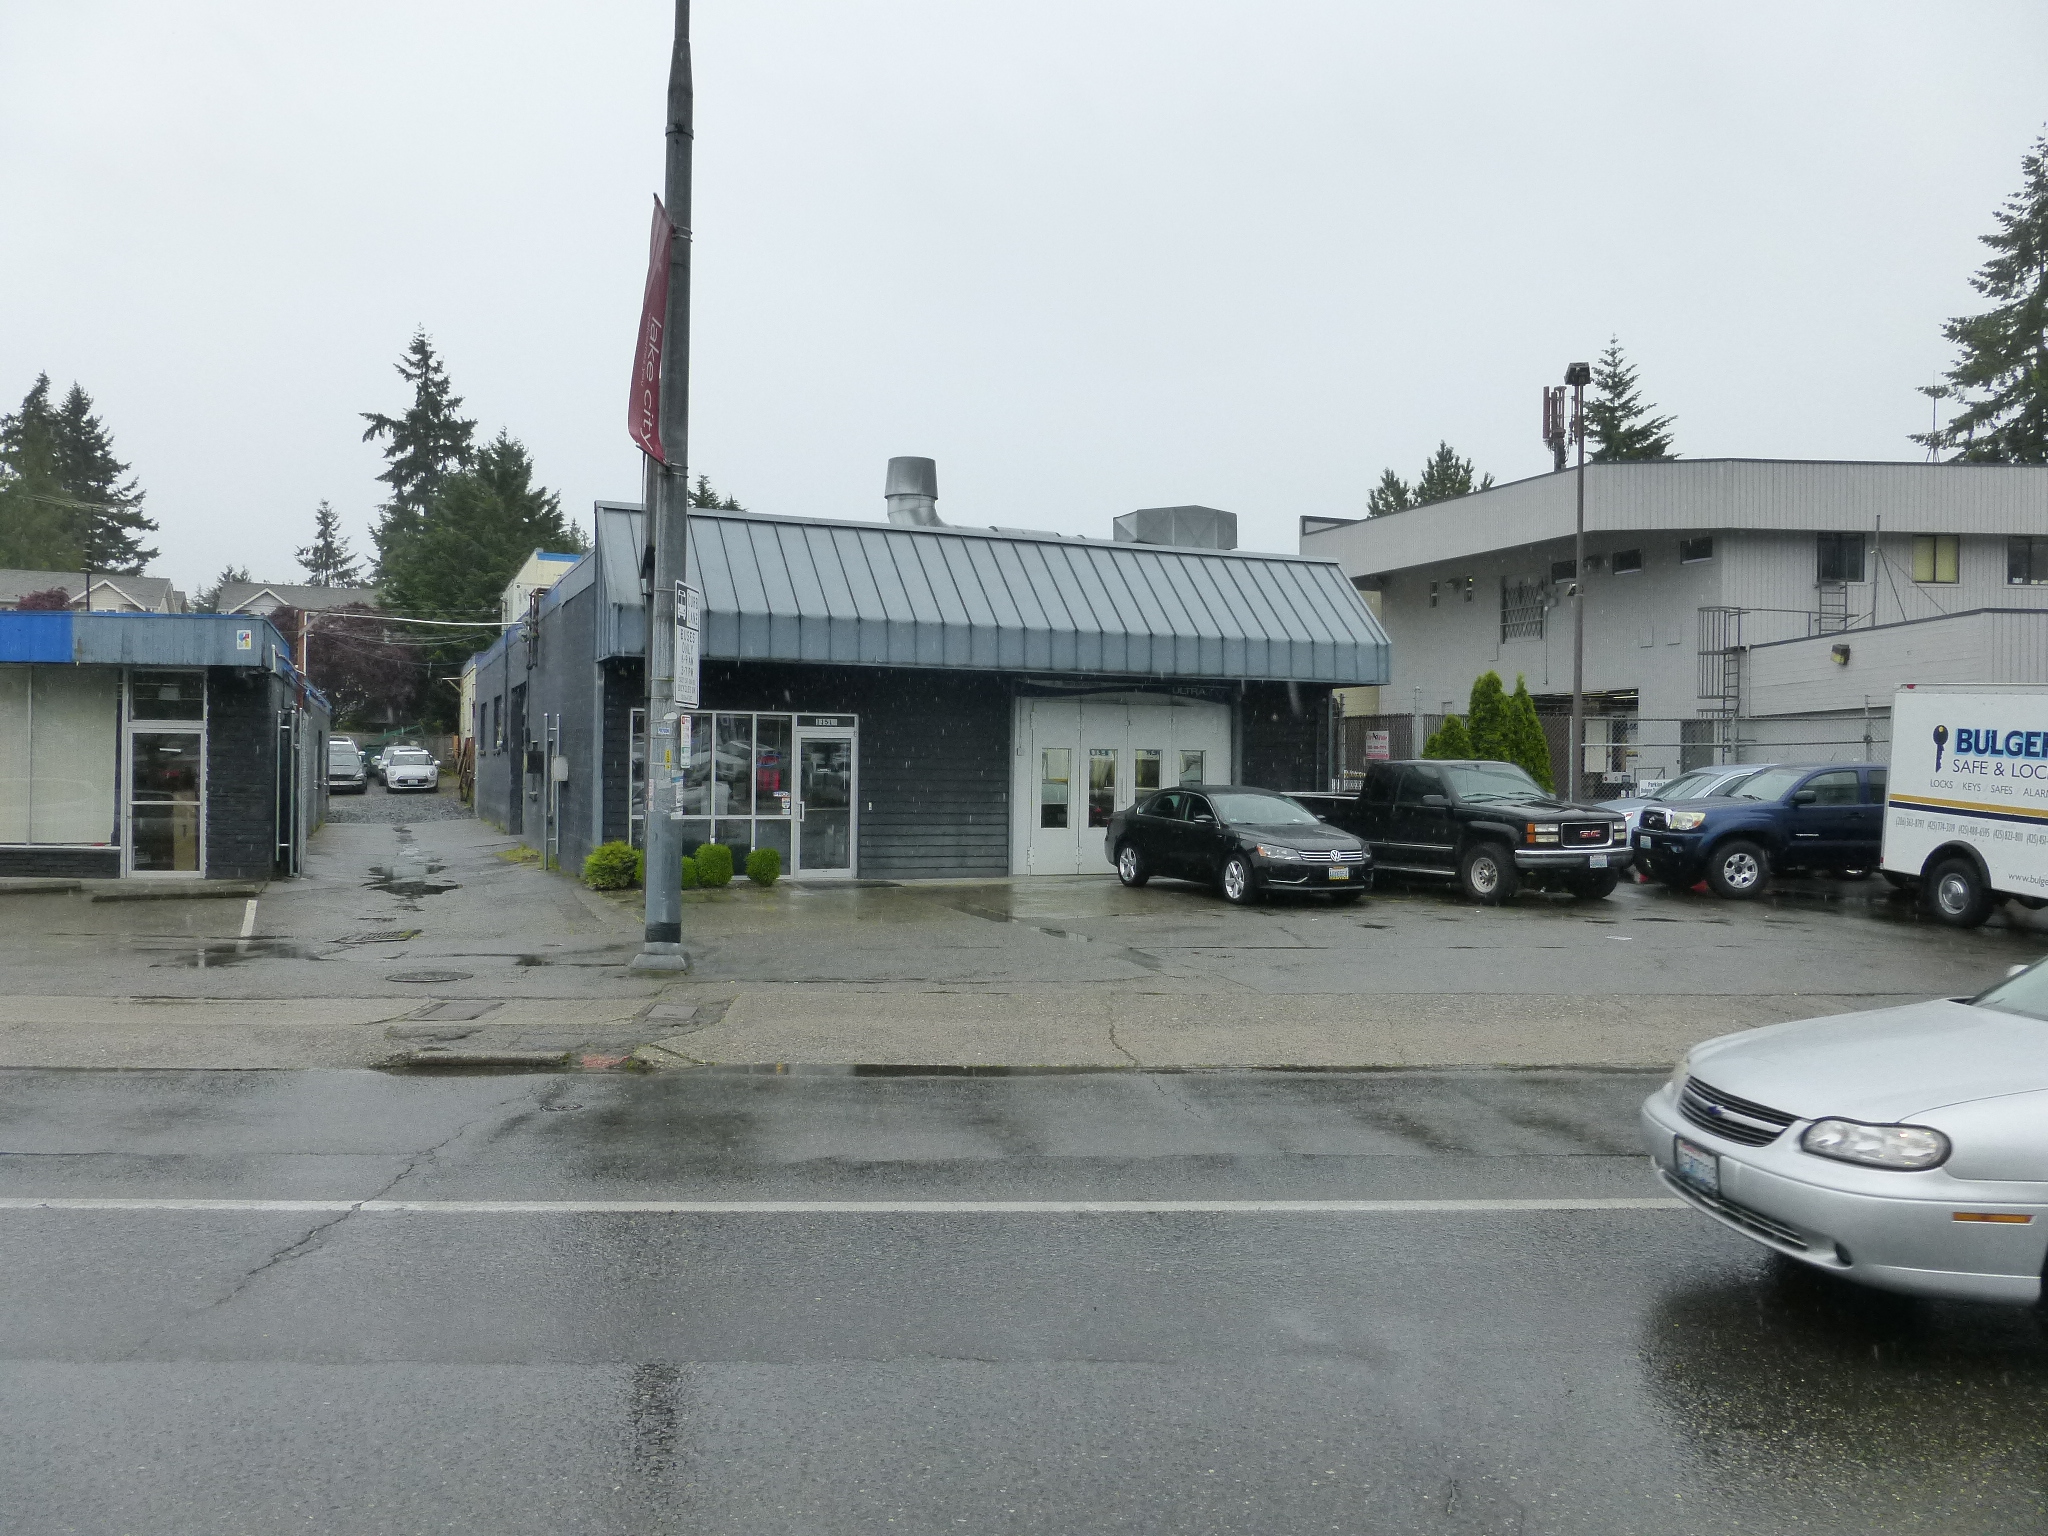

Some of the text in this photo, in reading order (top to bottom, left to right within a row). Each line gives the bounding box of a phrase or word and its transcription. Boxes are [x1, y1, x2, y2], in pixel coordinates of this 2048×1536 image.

[640, 316, 662, 451] lake city
[680, 629, 696, 643] BUSES
[1953, 759, 2048, 779] SAFE & LOC
[1930, 779, 1953, 789] LOCKS
[1962, 782, 1981, 792] KEYS
[1990, 784, 2013, 795] SAFES
